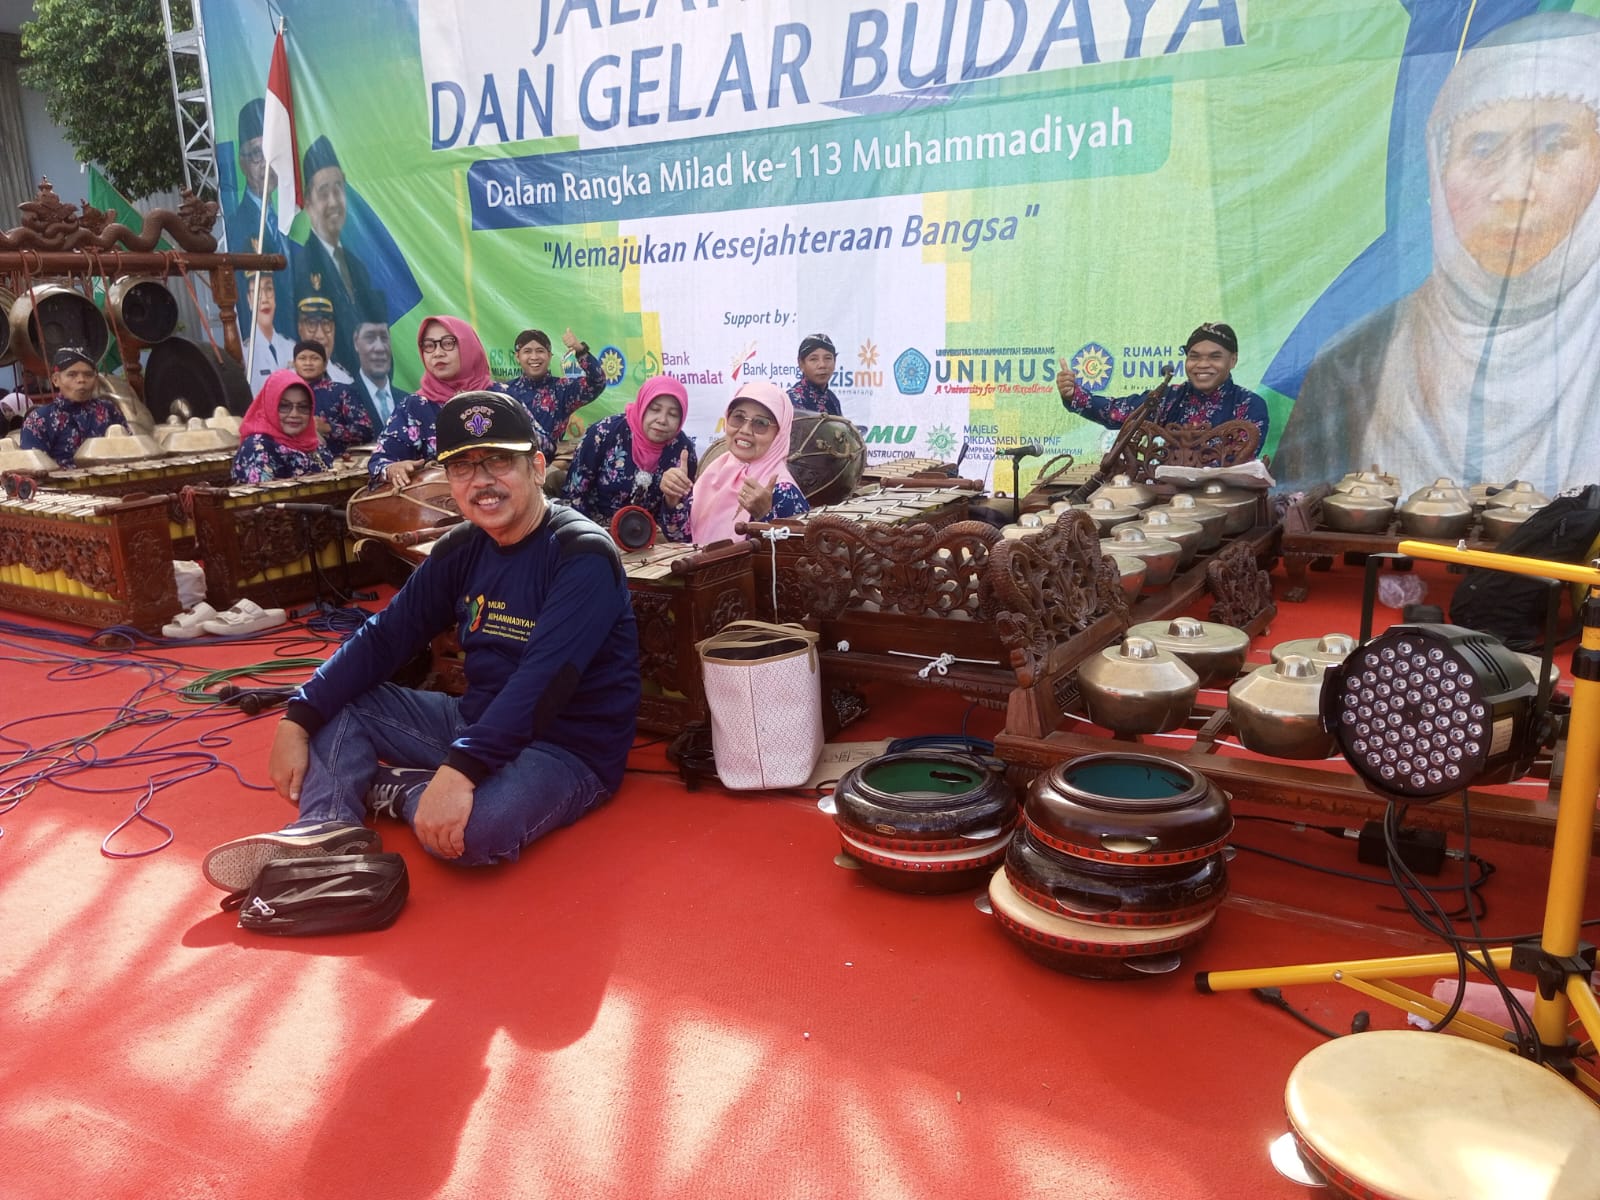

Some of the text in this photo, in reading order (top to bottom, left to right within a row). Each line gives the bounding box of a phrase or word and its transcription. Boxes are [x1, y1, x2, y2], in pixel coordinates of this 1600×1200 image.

[432, 0, 1247, 151] DAN GELAR BUDAYA
[486, 106, 1133, 208] Dalam Rangka Milad ke-113 Muhammadiyah
[543, 203, 1040, 272] "Memajukan Kesejahteraan Bangsa"
[723, 311, 771, 328] Support
[774, 308, 790, 327] by
[661, 351, 690, 366] Bank
[1022, 346, 1055, 355] SEMARANG
[1123, 346, 1172, 357] RUMAH
[743, 362, 804, 379] Bank Jateng
[830, 366, 883, 387] zismu
[935, 358, 1055, 383] UNIMUS
[1123, 360, 1184, 378] UNIM
[981, 384, 995, 396] for
[997, 384, 1011, 393] The
[460, 405, 495, 420] SCOUT
[963, 425, 998, 435] MAJELIS
[963, 436, 1061, 445] DIKDASMEN DAN PNF
[867, 449, 916, 459] NSTRUCTION
